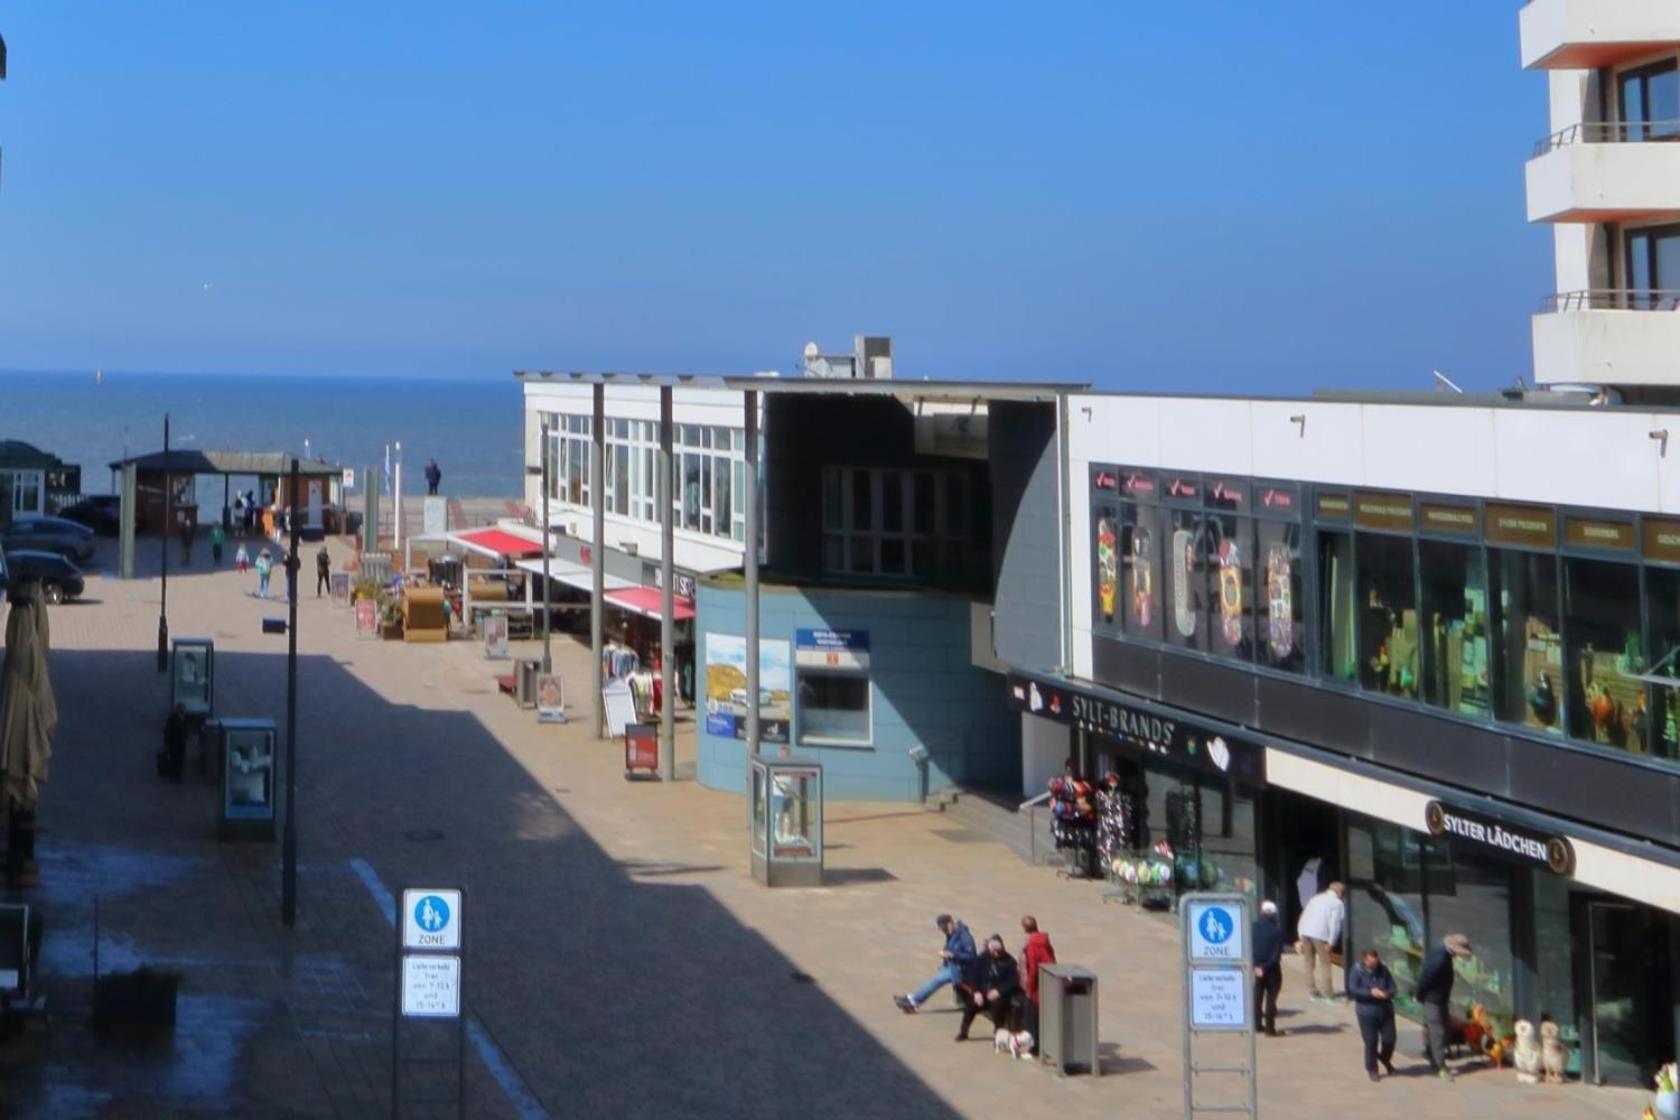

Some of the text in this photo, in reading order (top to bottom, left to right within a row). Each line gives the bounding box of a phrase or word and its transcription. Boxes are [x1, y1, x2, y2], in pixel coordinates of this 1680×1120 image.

[1072, 695, 1174, 745] SYLT-BRANDS
[1443, 814, 1547, 861] SYLTER LÄDCHEN
[418, 934, 444, 945] ZONE
[1203, 946, 1230, 956] ZONE
